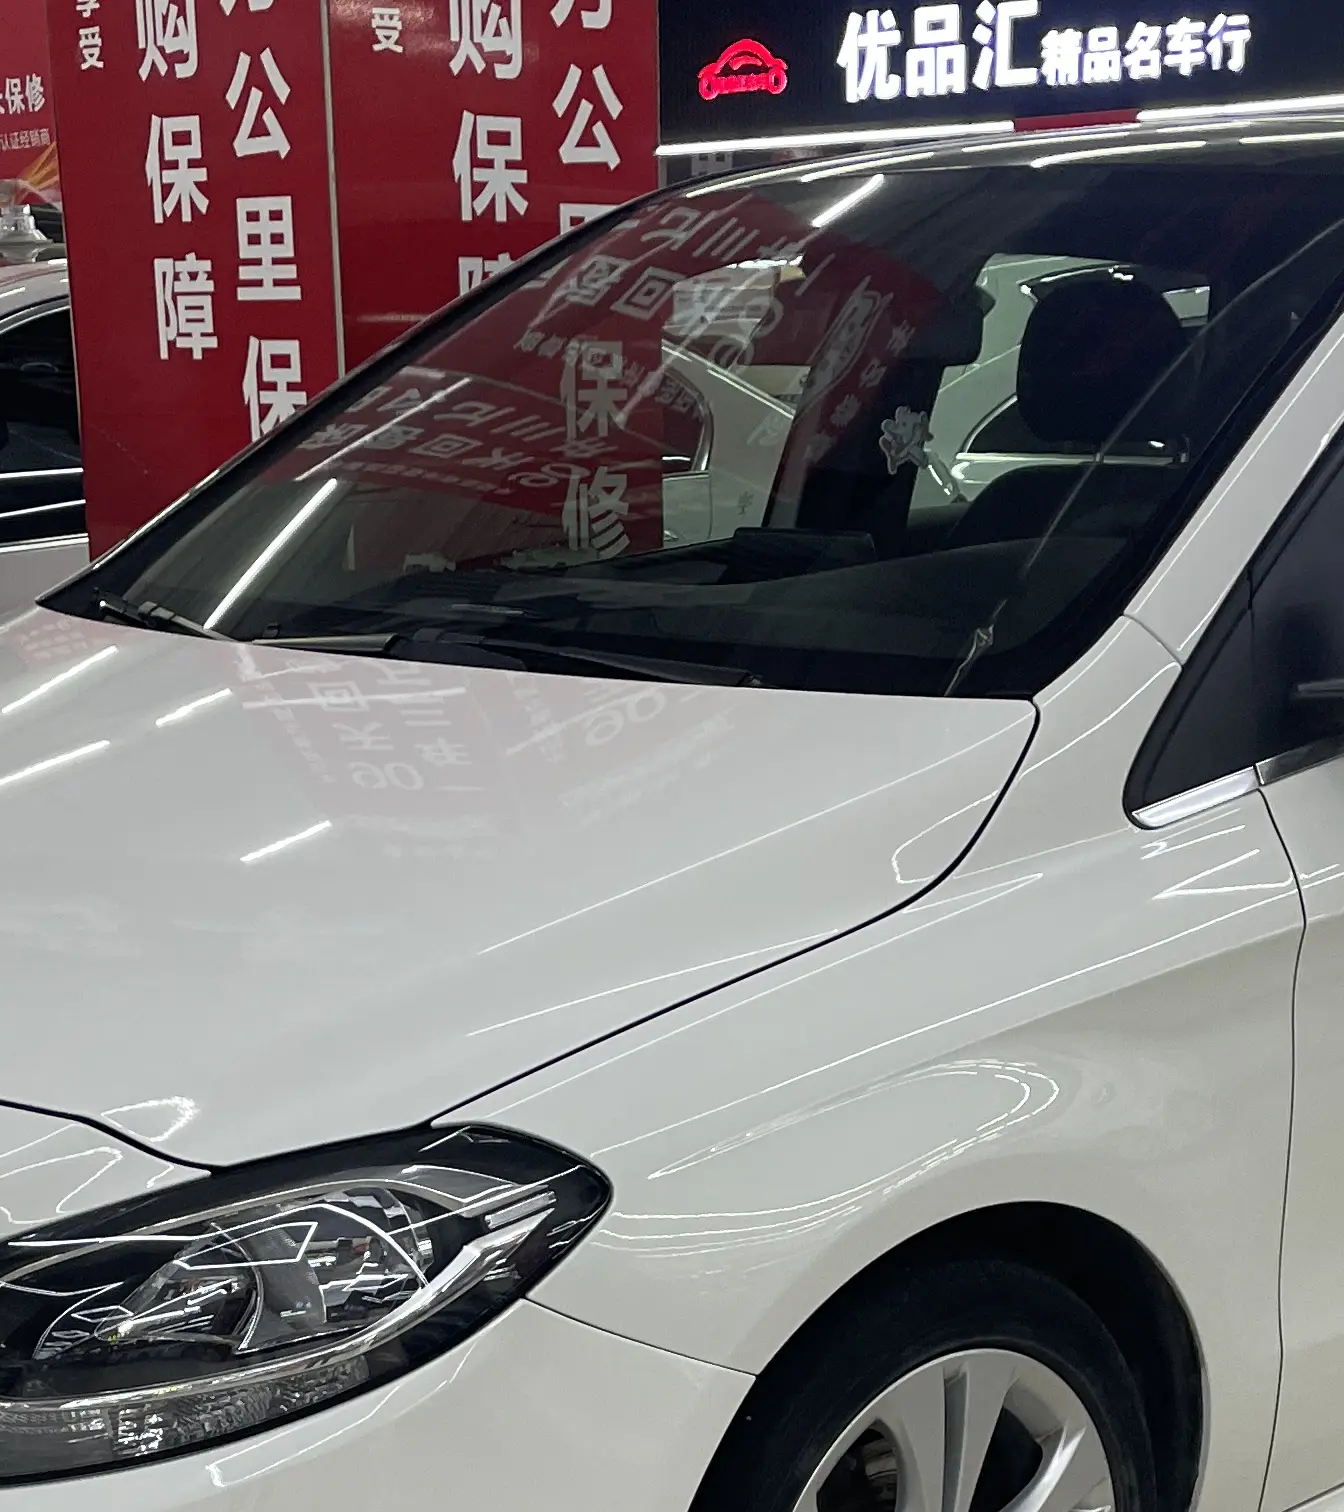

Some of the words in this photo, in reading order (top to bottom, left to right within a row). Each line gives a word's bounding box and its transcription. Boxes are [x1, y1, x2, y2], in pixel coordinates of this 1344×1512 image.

[372, 7, 404, 53] 受
[836, 0, 1039, 102] 优品汇
[1040, 13, 1252, 87] 精品名车行
[219, 0, 307, 442] 公里保
